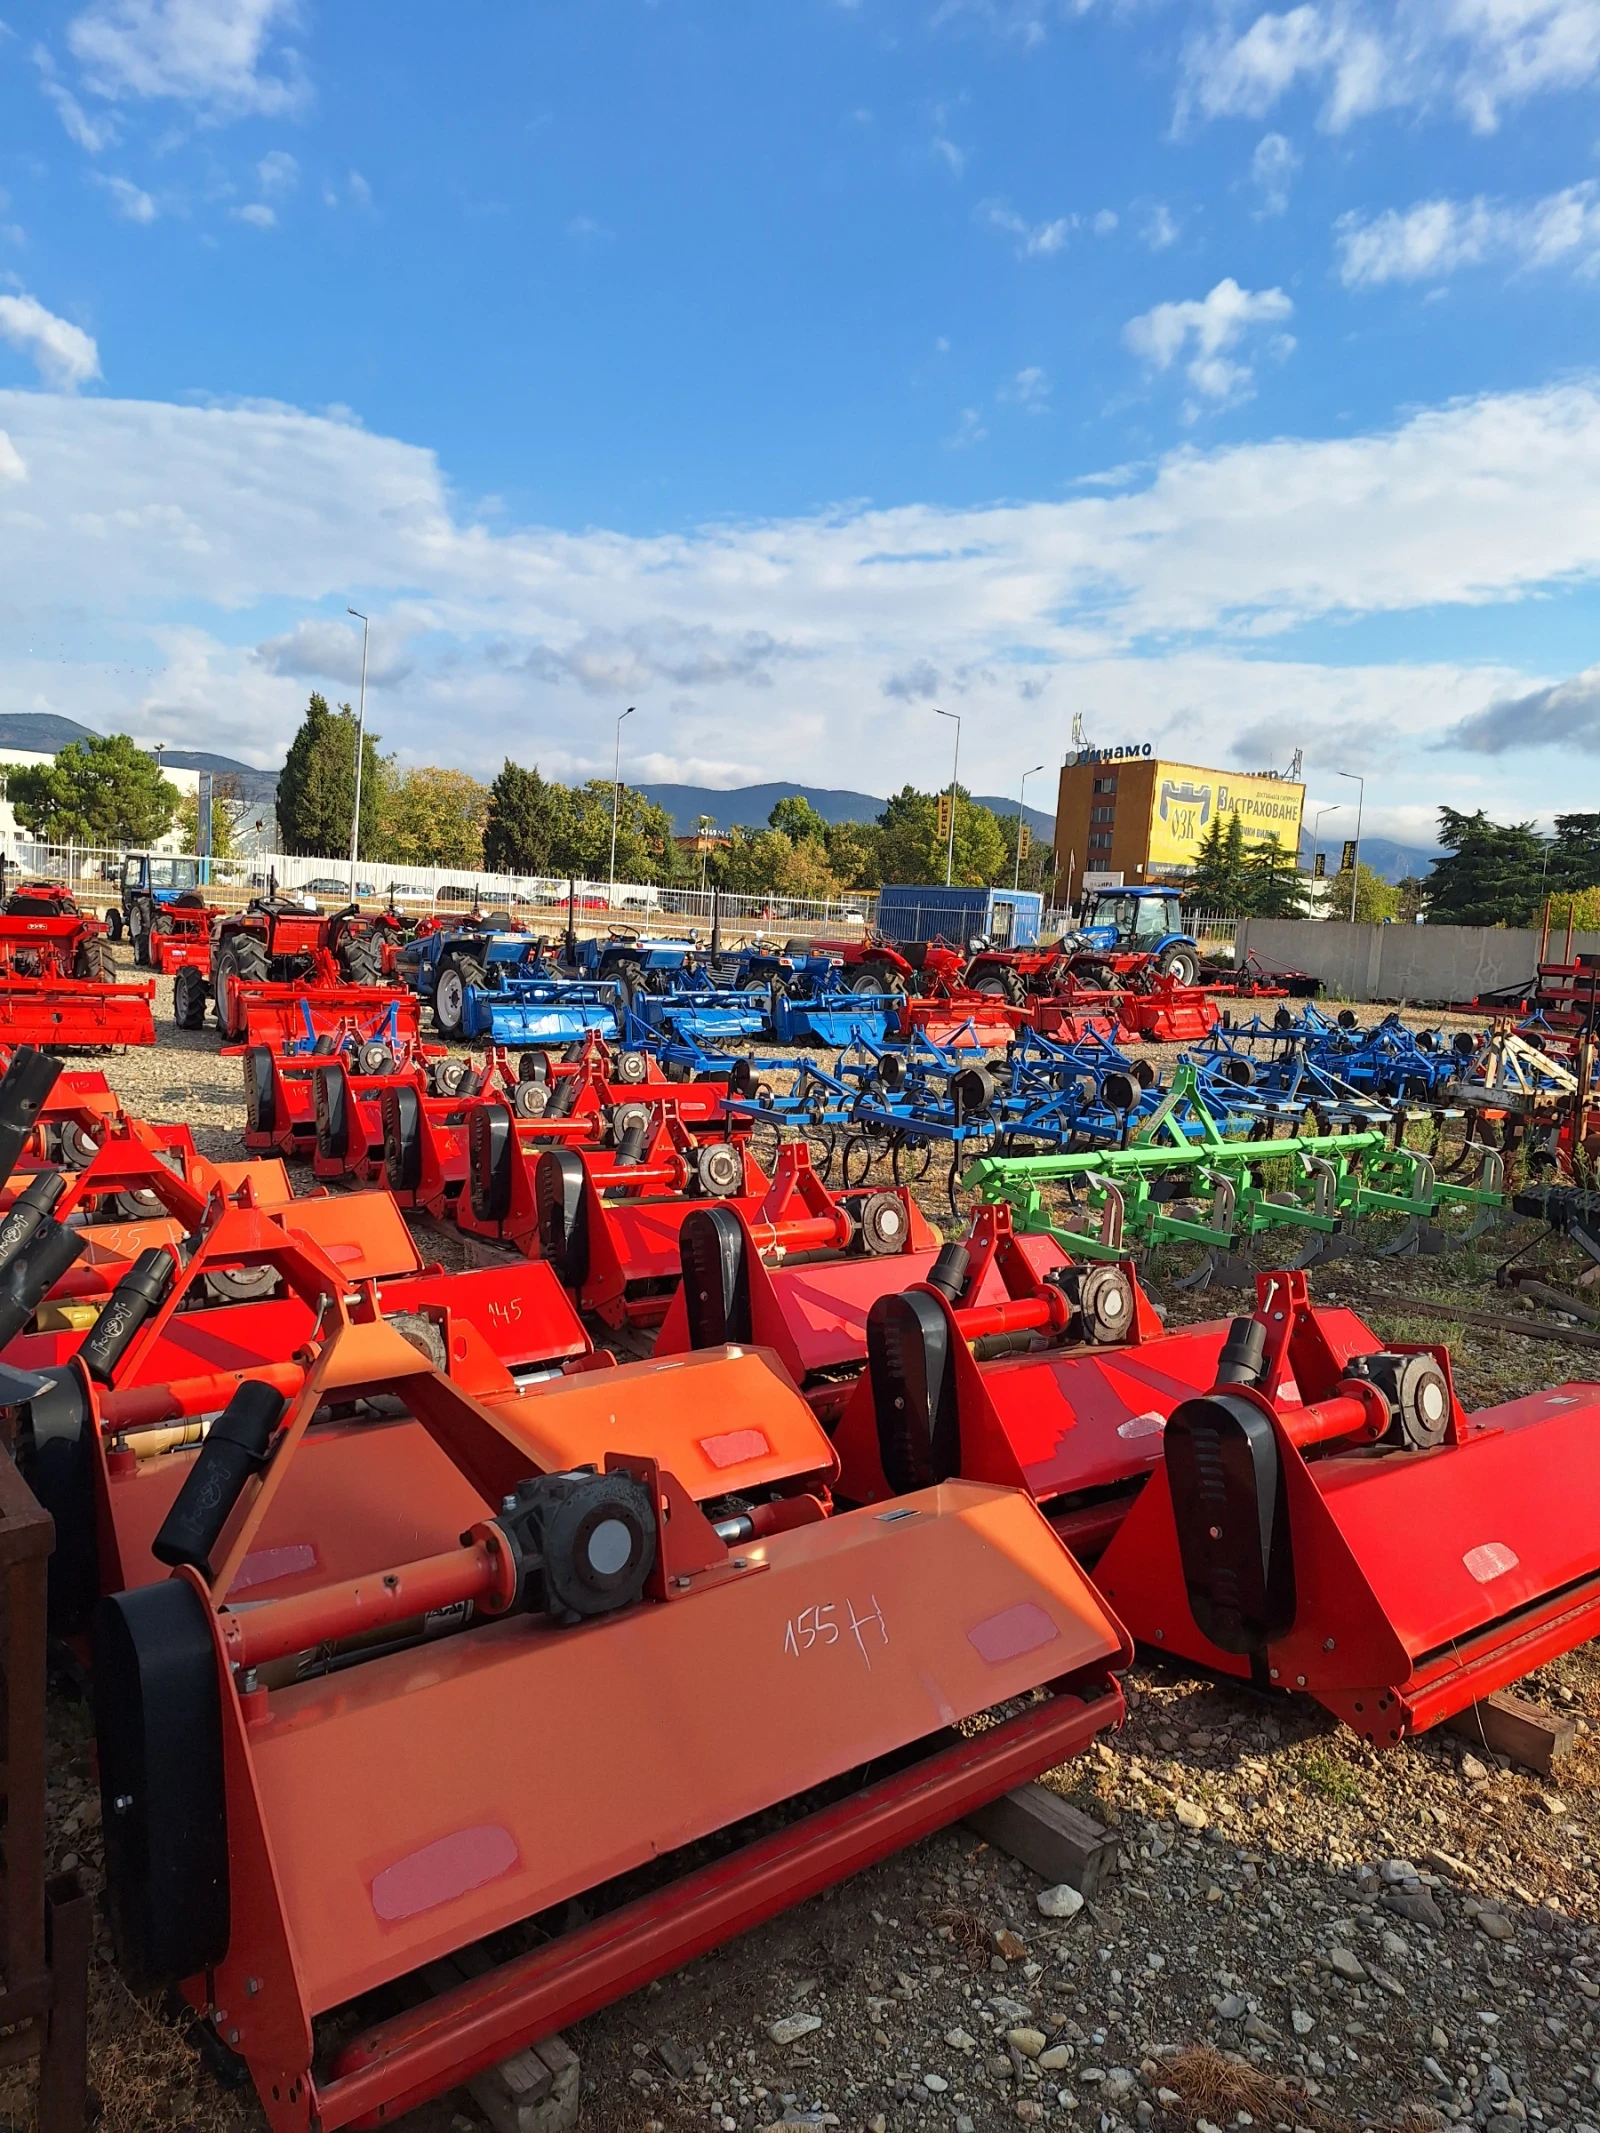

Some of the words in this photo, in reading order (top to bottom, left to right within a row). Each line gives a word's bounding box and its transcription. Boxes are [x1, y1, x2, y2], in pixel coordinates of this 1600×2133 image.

[940, 800, 948, 837] EFBET
[1217, 786, 1298, 821] ЗАСТРАХОВАНЕ
[488, 1297, 522, 1328] 145
